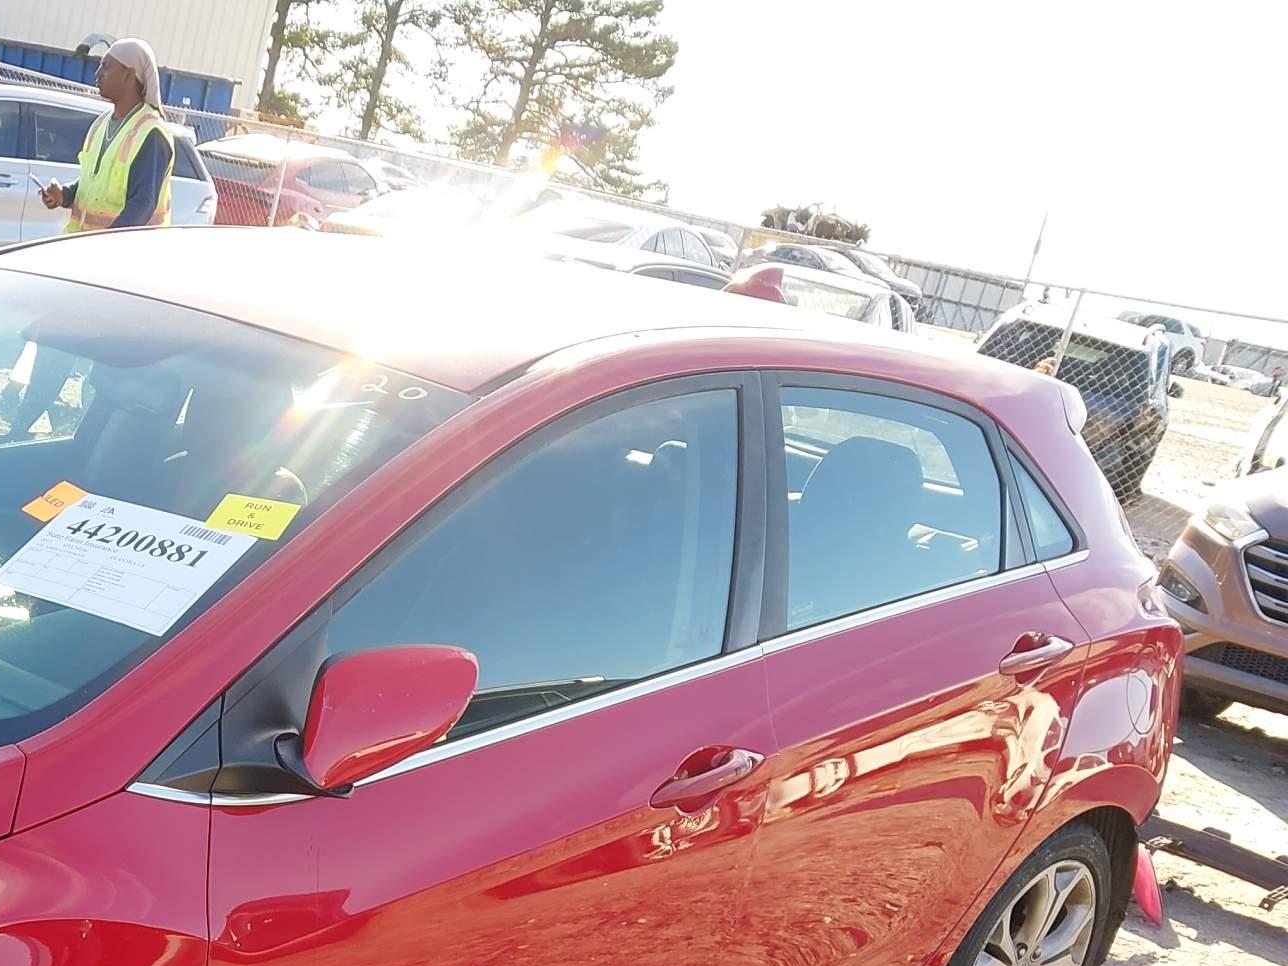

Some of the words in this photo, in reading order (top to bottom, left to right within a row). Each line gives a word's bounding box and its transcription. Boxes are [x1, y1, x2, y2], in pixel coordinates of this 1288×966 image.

[244, 502, 272, 512] RUN
[226, 518, 265, 531] DRIVE
[65, 519, 209, 568] 44200881
